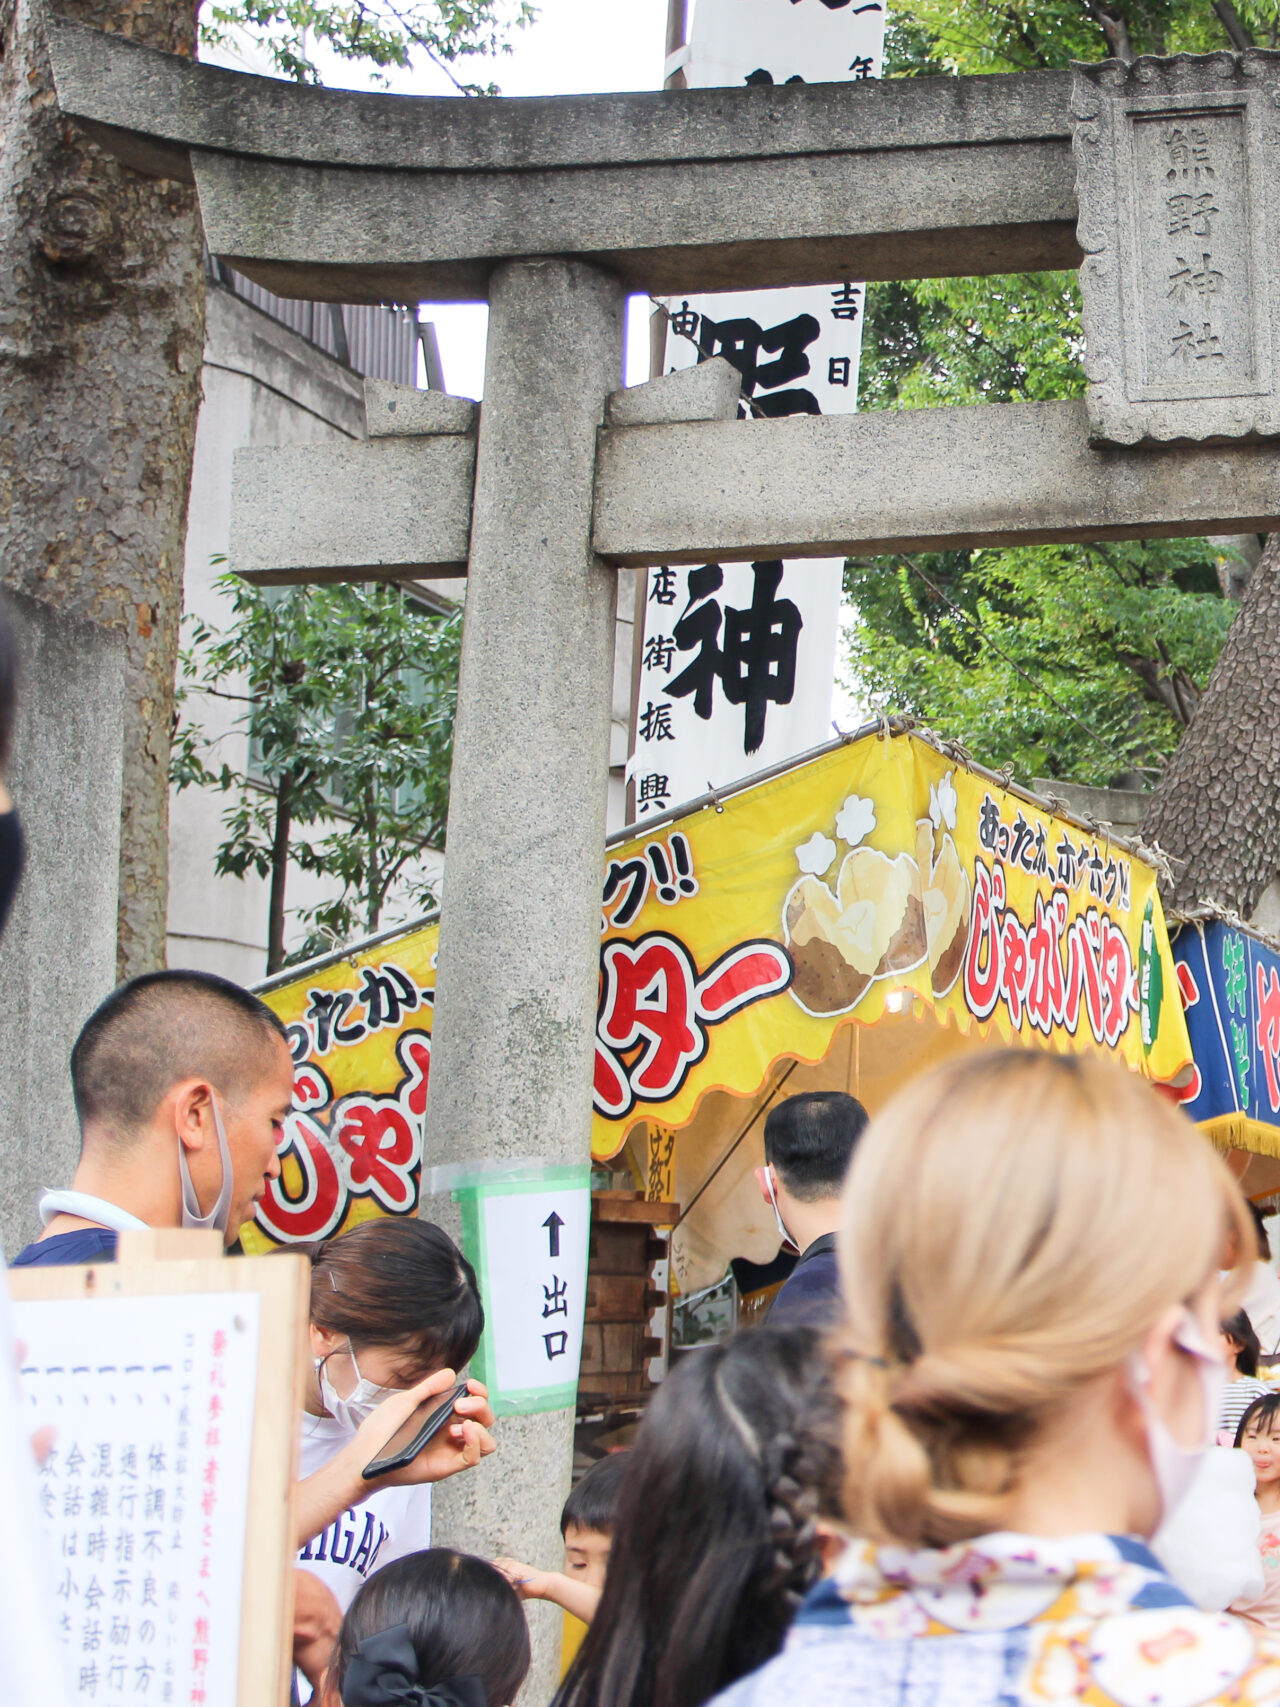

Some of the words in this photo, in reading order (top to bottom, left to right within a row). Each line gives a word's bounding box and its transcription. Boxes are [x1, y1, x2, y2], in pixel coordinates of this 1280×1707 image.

[1164, 128, 1225, 364] 熊野神社
[827, 282, 861, 388] 吉日
[637, 565, 678, 813] 店街振興
[661, 557, 804, 758] 神
[597, 832, 699, 928] ク!!
[541, 1273, 568, 1362] 出口
